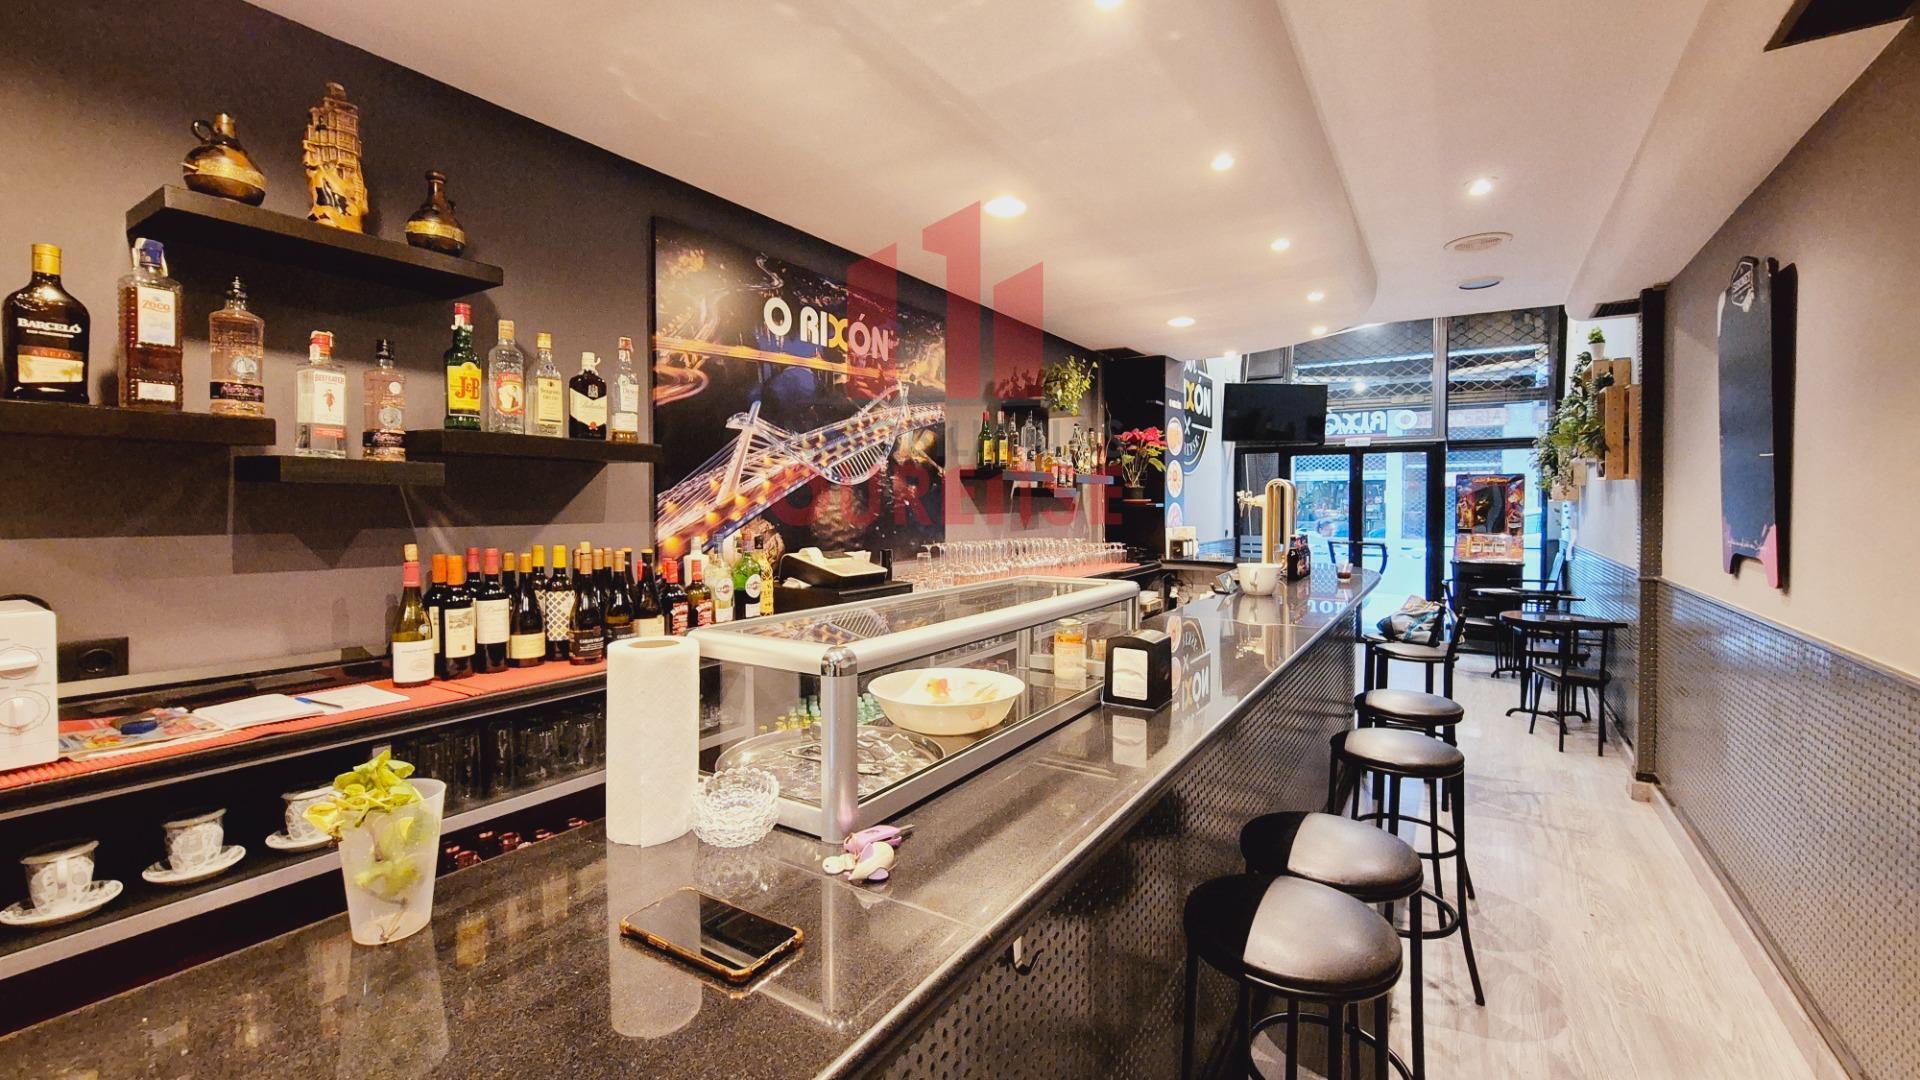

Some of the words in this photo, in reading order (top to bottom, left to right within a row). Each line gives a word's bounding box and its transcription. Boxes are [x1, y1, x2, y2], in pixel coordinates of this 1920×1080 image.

[17, 317, 83, 334] BARCELÓ
[763, 297, 793, 336] O
[800, 314, 889, 361] RIXÓN
